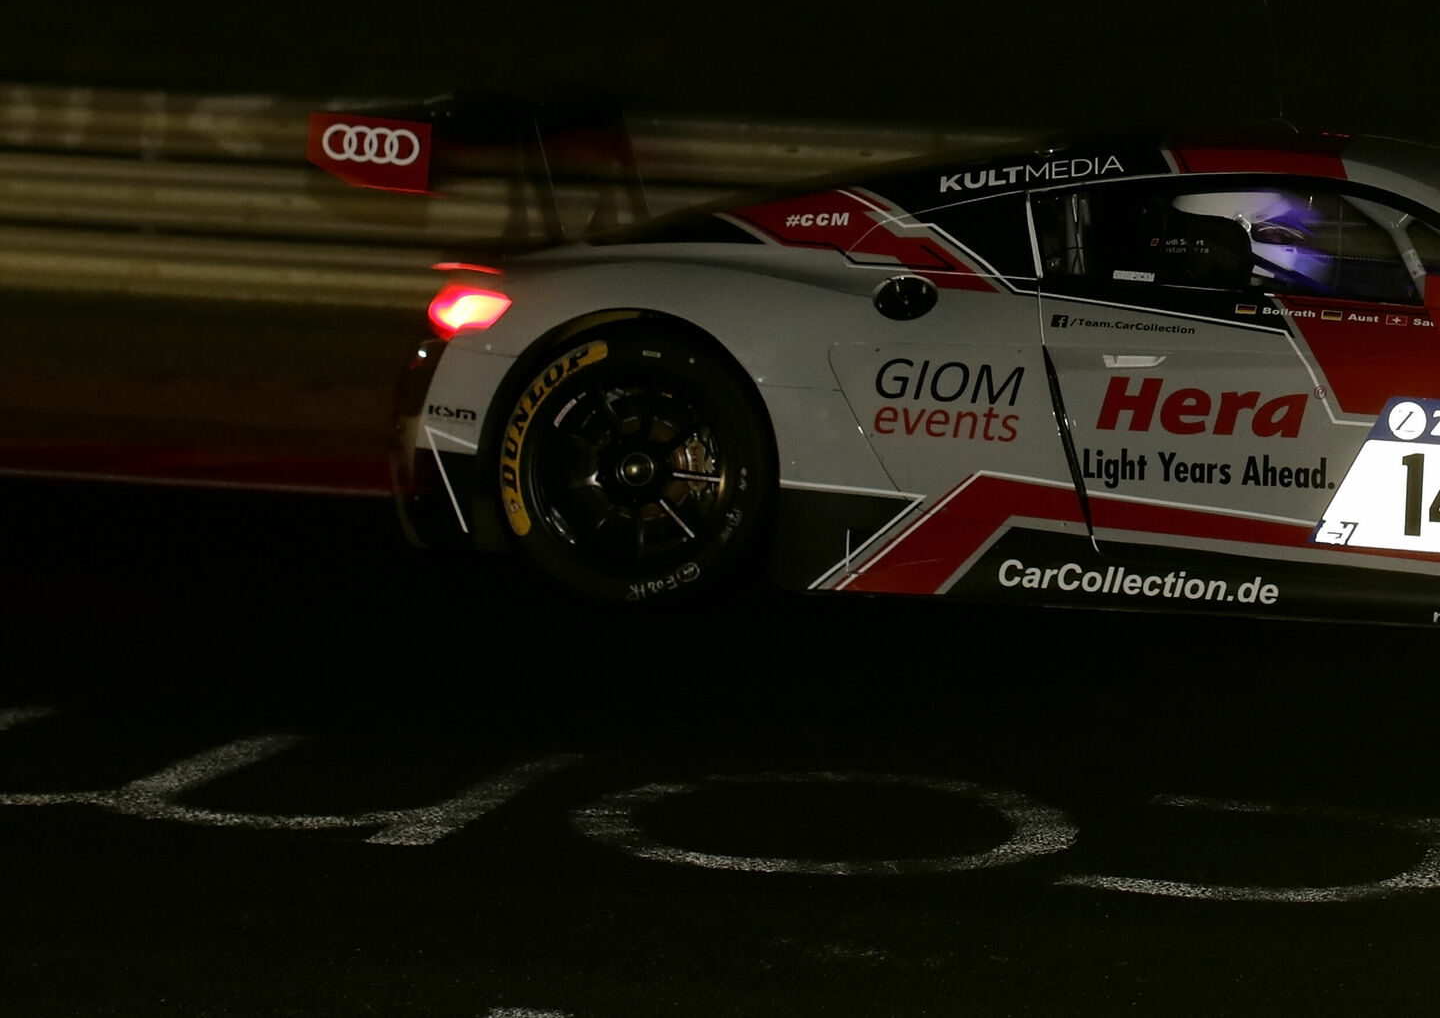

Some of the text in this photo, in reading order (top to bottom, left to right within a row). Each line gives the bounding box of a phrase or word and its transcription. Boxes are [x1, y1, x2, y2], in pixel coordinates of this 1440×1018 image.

[940, 155, 1124, 193] KULTMEDIA
[785, 211, 850, 228] #CCM
[1347, 313, 1380, 324] Aust
[875, 357, 1024, 408] GIOM
[503, 346, 591, 493] DUNLOP
[873, 403, 1019, 443] events
[1096, 376, 1309, 439] Hera
[1082, 451, 1335, 491] Light Years Ahead.
[998, 559, 1279, 606] CarCollection.de
